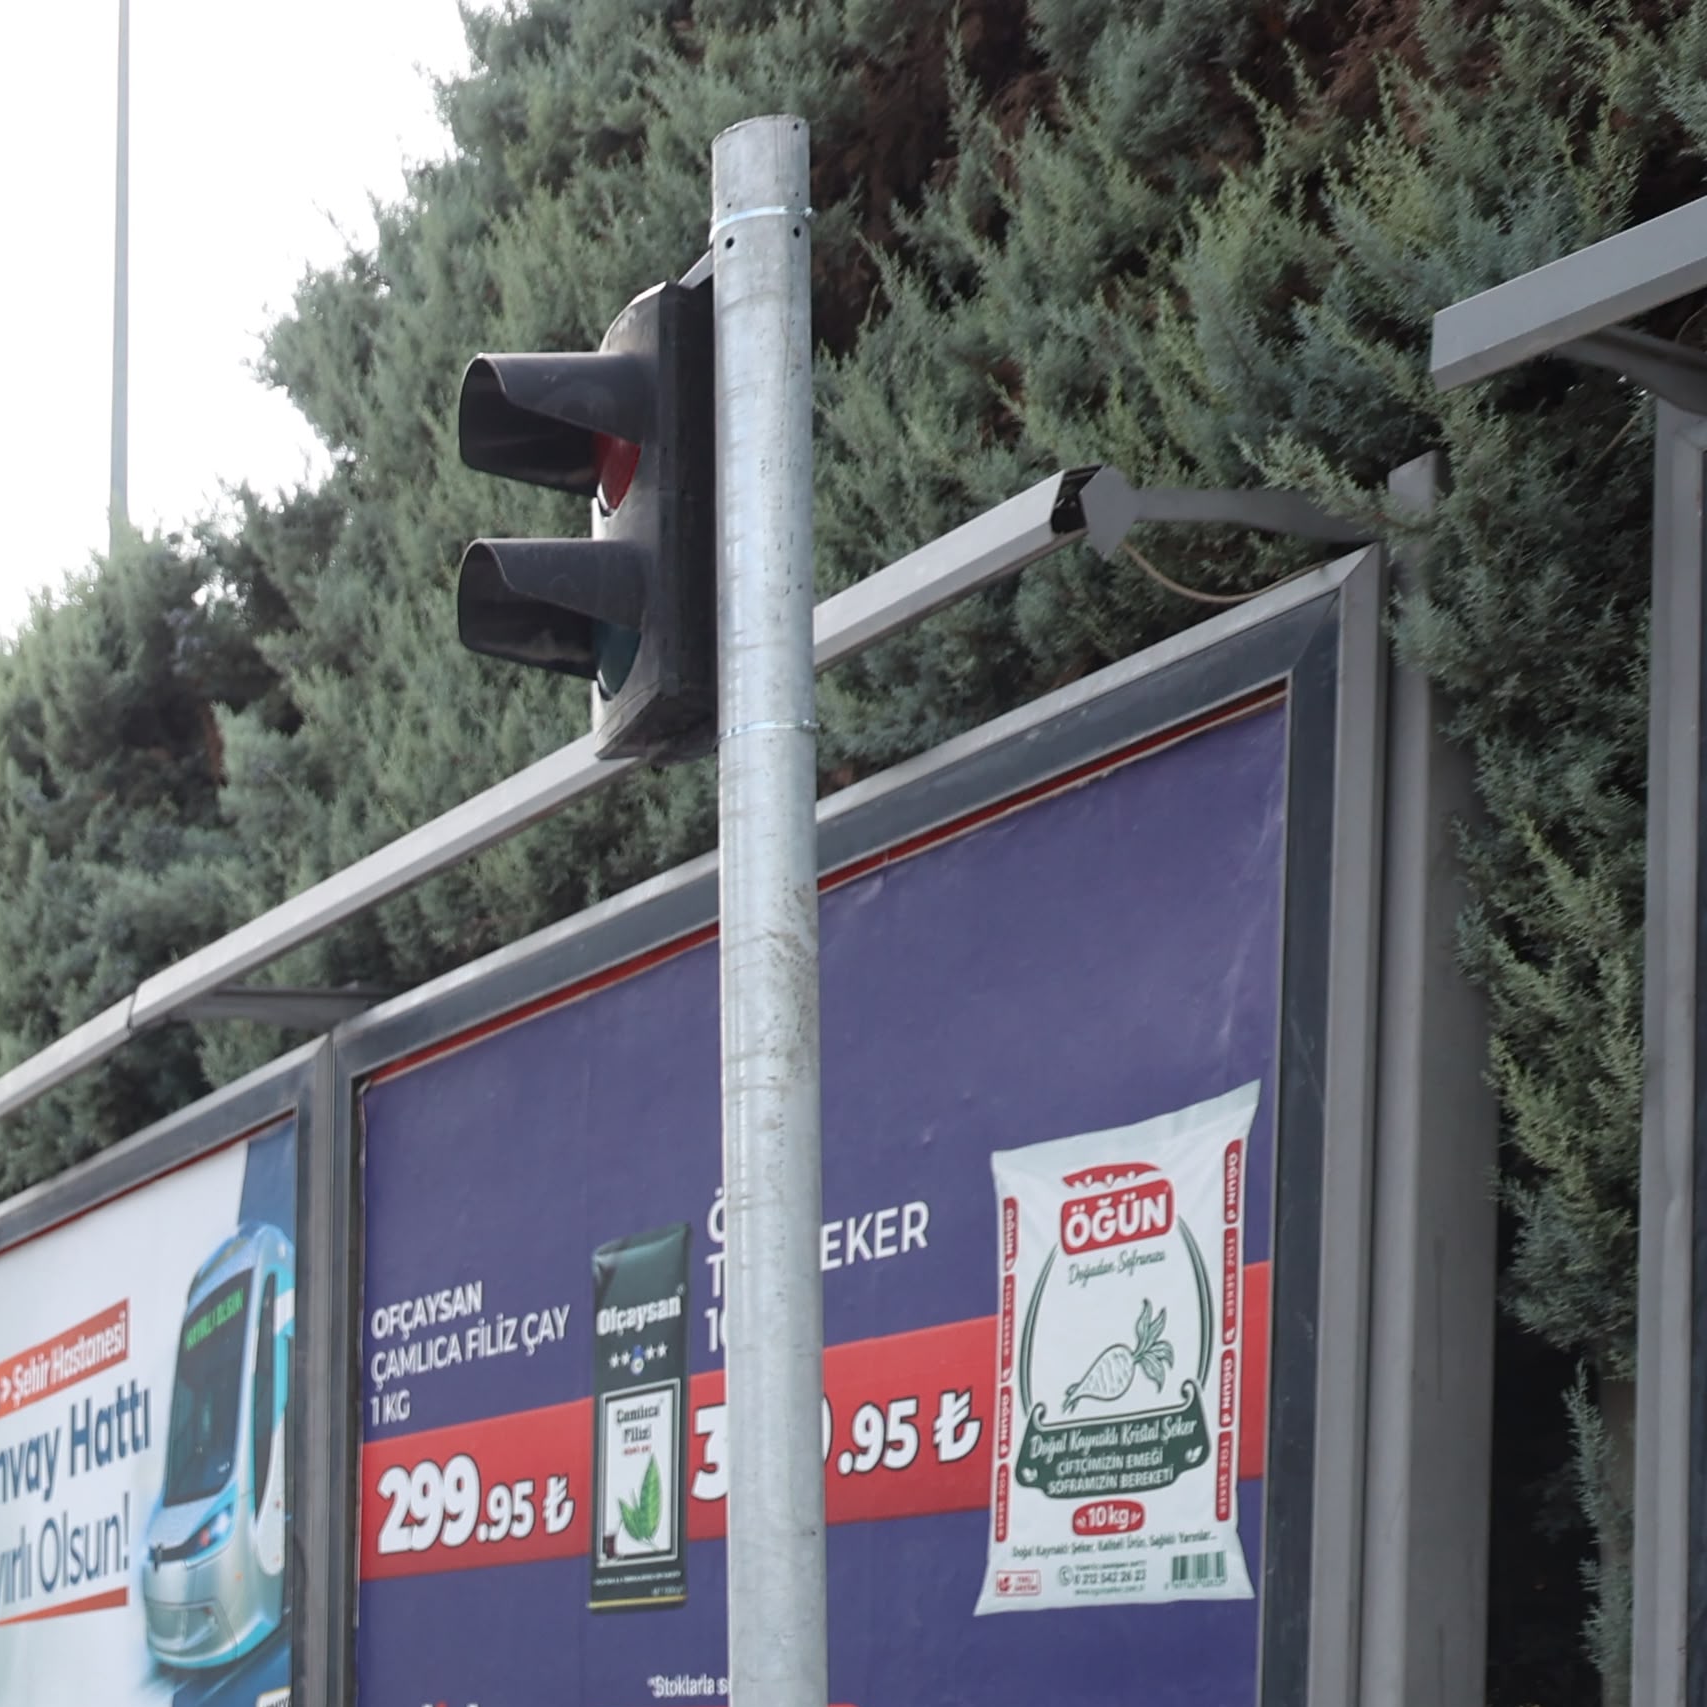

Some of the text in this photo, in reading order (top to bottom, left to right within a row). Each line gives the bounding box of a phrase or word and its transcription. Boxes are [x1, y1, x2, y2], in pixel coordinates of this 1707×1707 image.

[820, 1200, 929, 1271] EKER
[1065, 1192, 1167, 1248] ÖĞÜN
[371, 1281, 484, 1342] OFÇAYSAN
[596, 1296, 682, 1336] Ofçaysan
[11, 1352, 51, 1408] Şehir
[50, 1310, 126, 1384] Hastanesi
[370, 1304, 571, 1391] ÇAMLICA FİLİZ ÇAY
[69, 1379, 153, 1478] Hattı
[370, 1391, 411, 1427] 1 KG
[1029, 1415, 1197, 1464] Doğal Kaynaklı Kristal Şeker
[1126, 1447, 1164, 1467] EMEĞİ
[377, 1453, 536, 1555] 299.95
[1088, 1504, 1130, 1531] 10 kg
[38, 1491, 130, 1594] Olsun!
